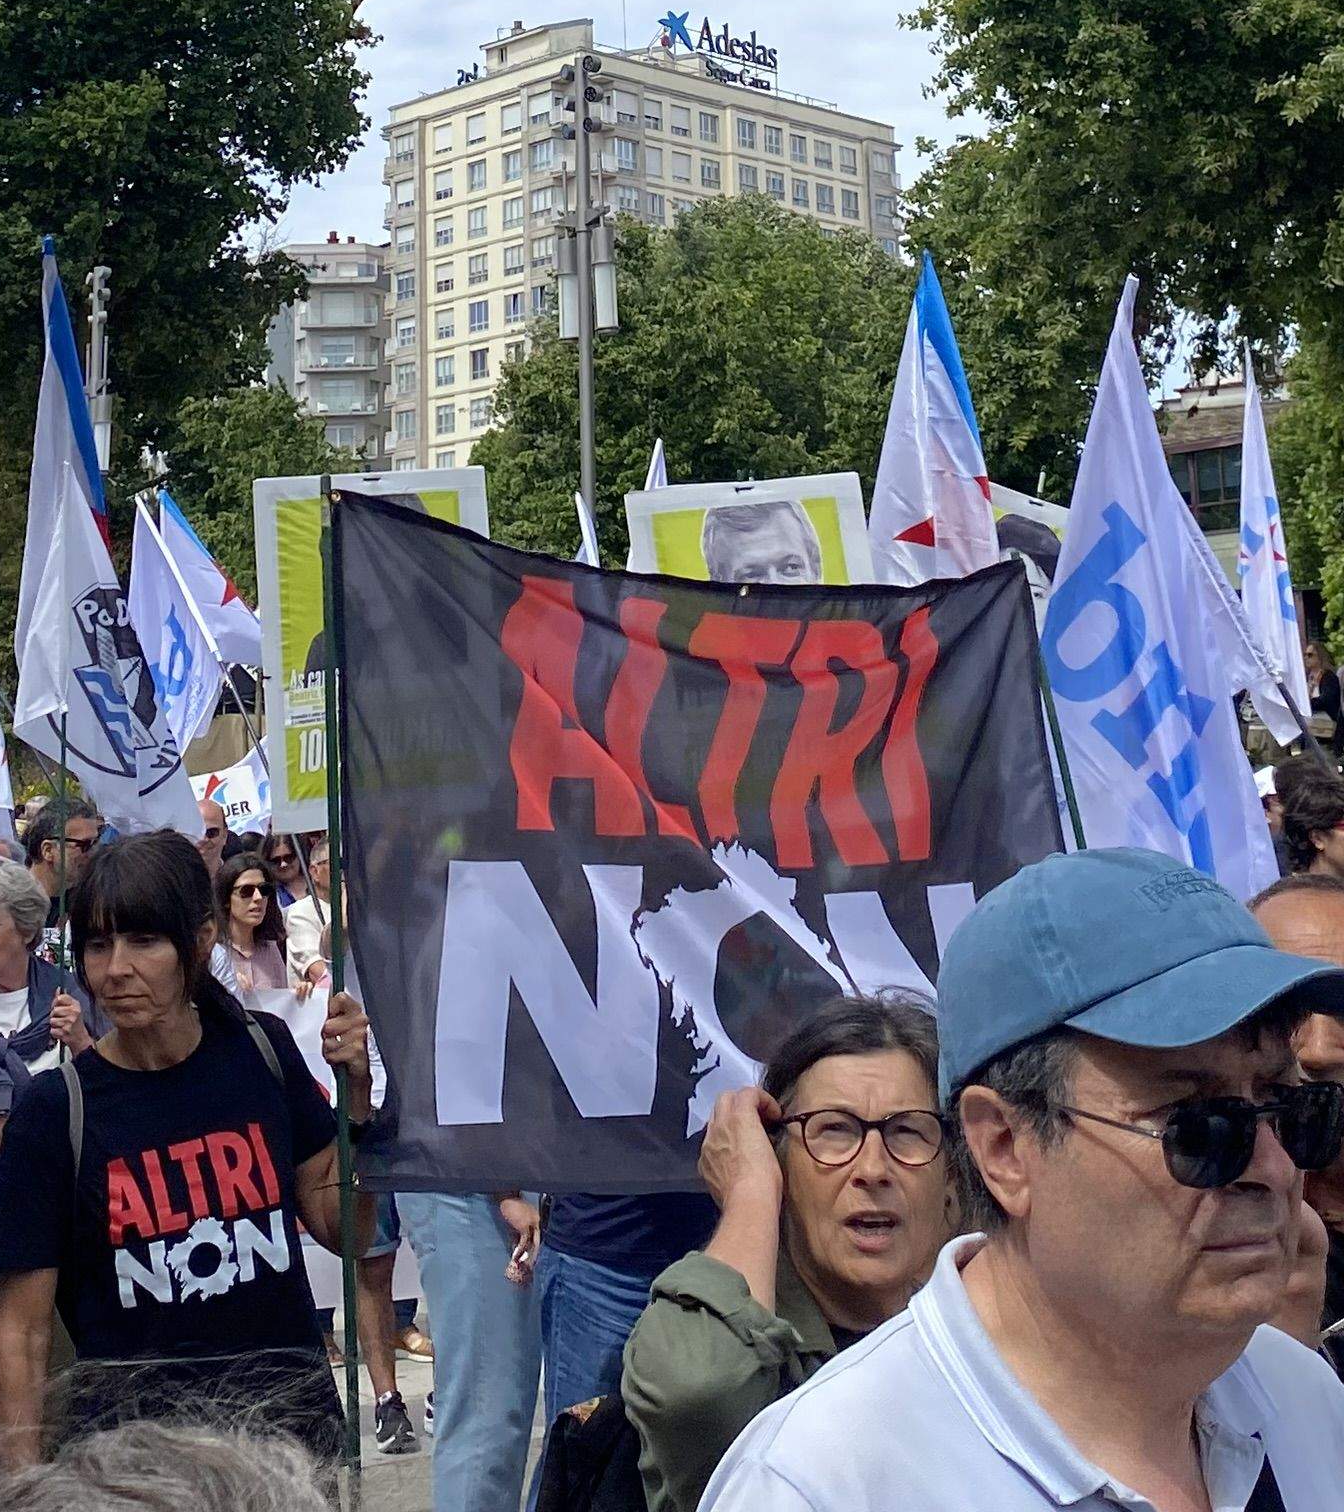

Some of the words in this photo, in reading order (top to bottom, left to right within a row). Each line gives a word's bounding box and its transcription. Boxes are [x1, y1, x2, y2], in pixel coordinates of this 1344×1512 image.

[697, 16, 777, 68] Adeslas
[501, 575, 939, 868] ALTRI
[107, 1123, 281, 1246] ALTRI
[115, 1209, 290, 1309] NON
